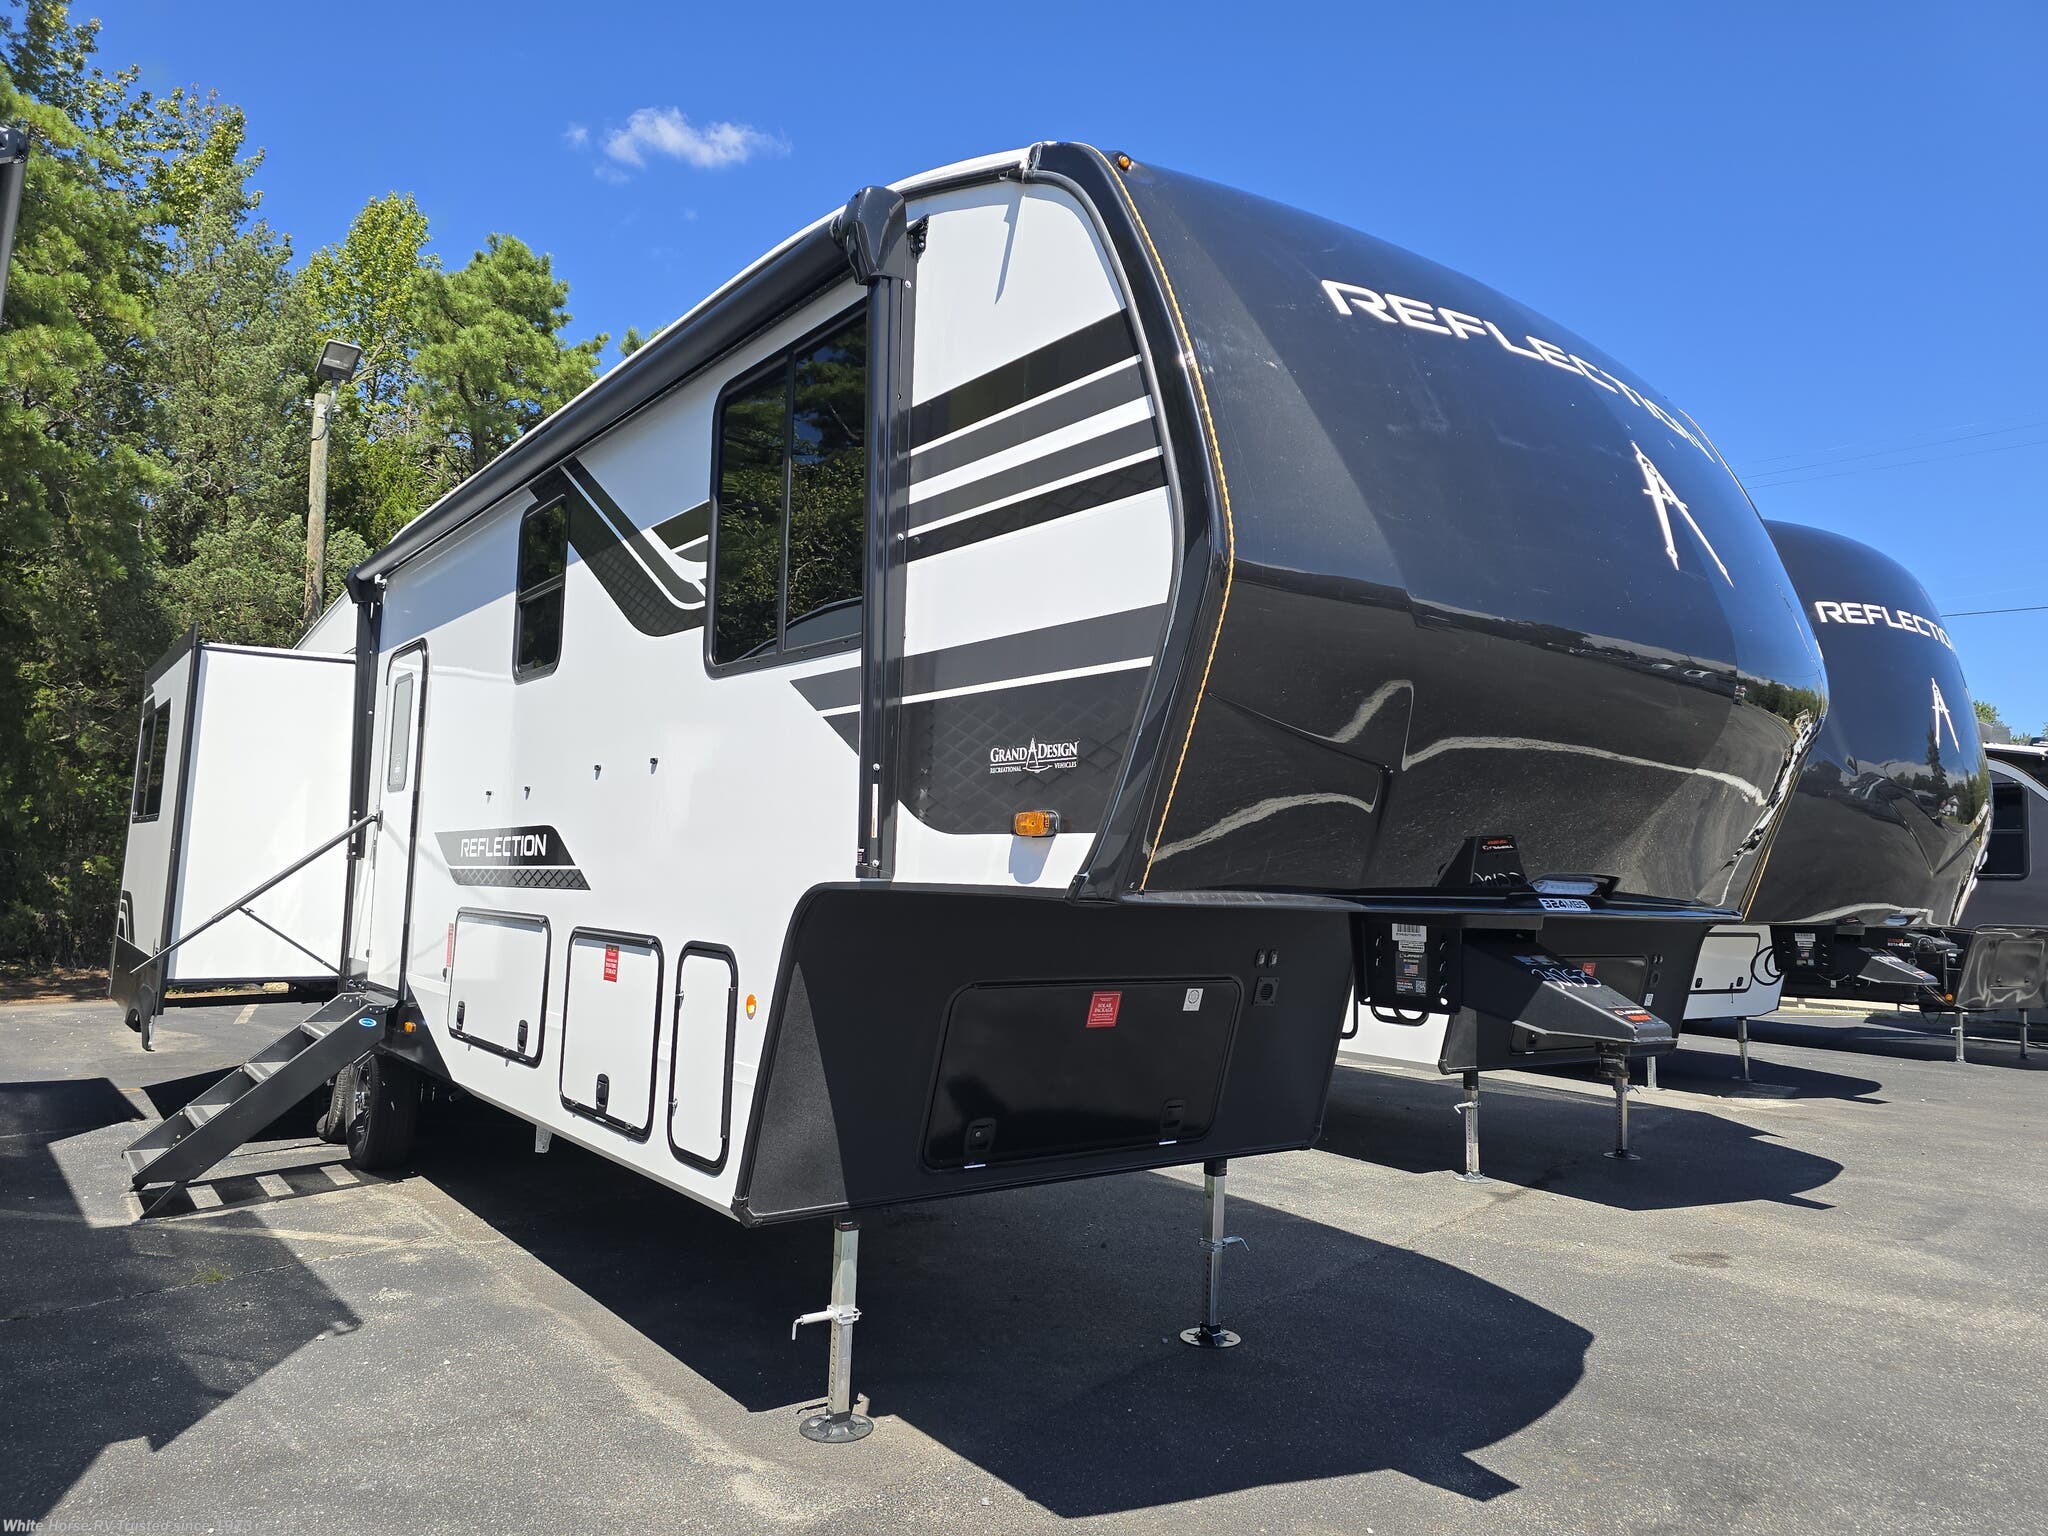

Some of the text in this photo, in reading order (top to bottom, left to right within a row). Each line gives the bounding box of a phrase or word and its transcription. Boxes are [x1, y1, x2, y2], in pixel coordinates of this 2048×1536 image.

[1814, 601, 1954, 651] REFLECTIO
[990, 741, 1079, 763] GRAND DESIGN
[460, 834, 547, 858] REFLECTION
[1541, 899, 1589, 909] 324MBS
